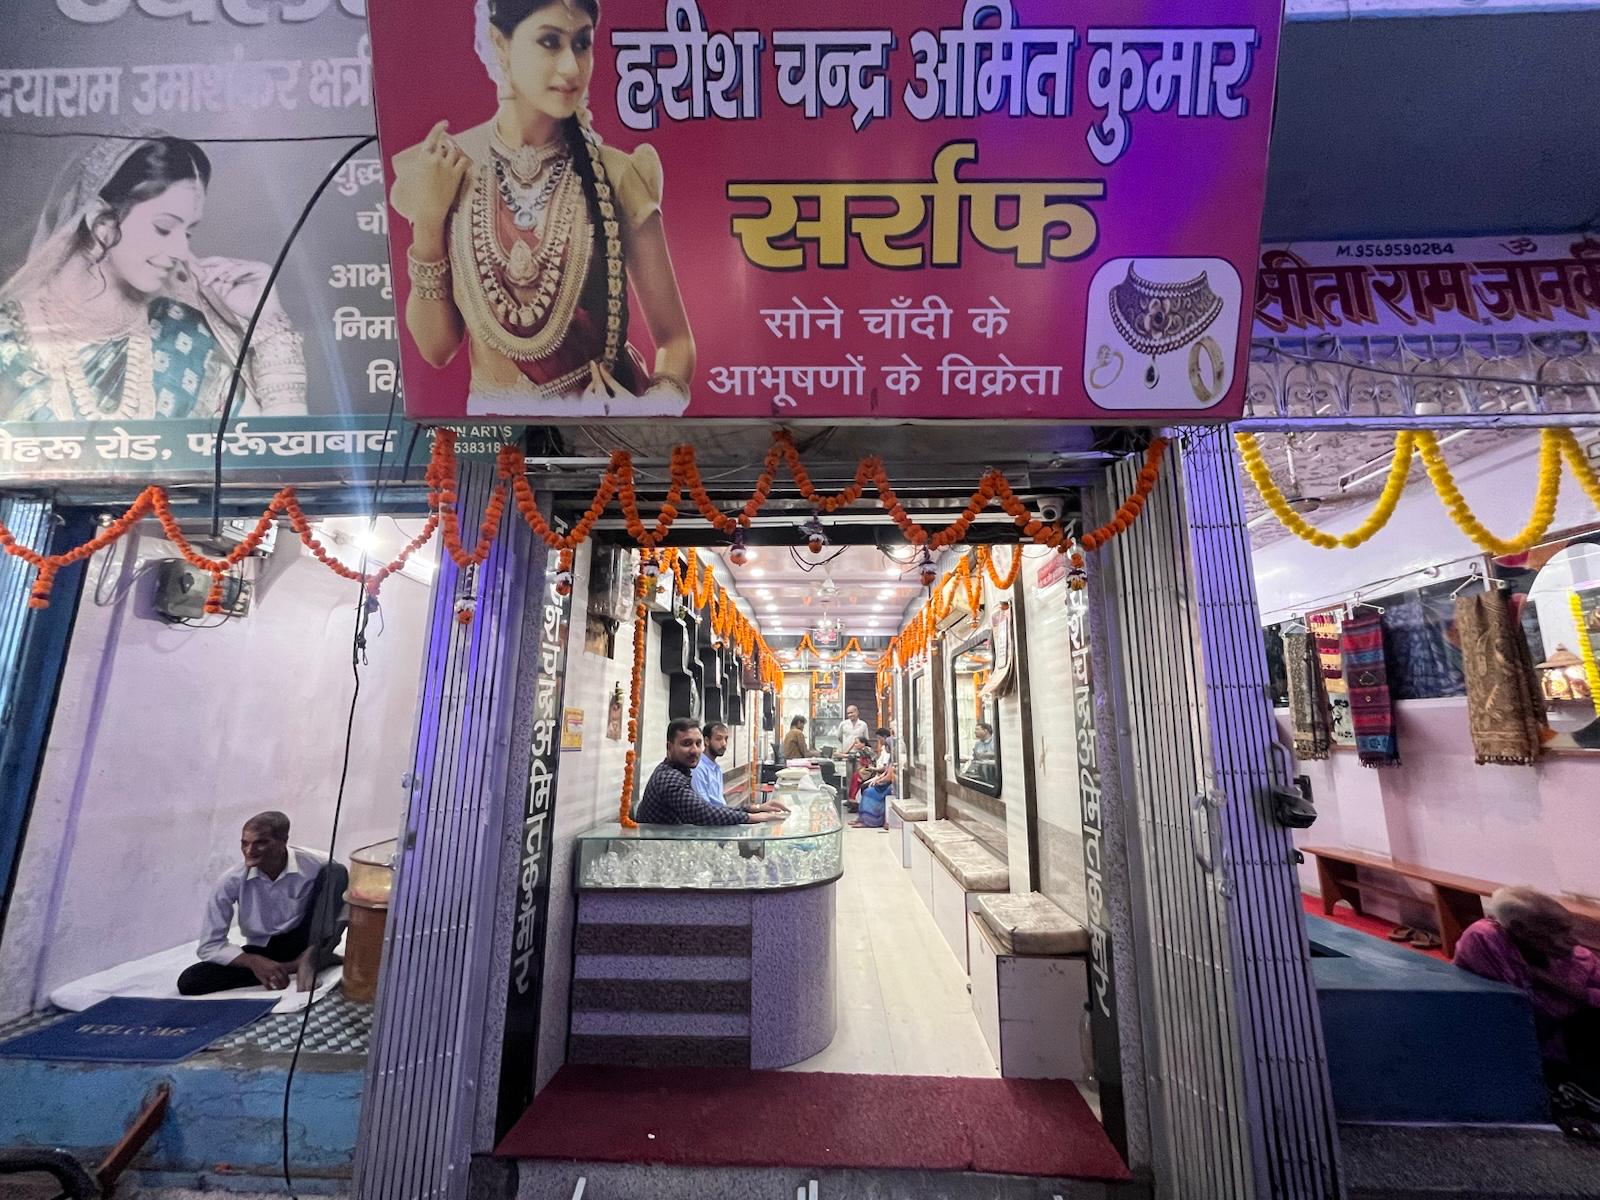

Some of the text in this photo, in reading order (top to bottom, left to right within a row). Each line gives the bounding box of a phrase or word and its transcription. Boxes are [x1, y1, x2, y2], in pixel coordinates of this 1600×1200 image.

[611, 0, 1259, 164] हरीश चन्द्र अमित कुमार
[726, 140, 1106, 271] सर्राफ
[760, 295, 1010, 340] सोने चाँदी के
[707, 352, 1062, 406] आभूषणों के विक्रेता
[95, 427, 172, 461] रोड,
